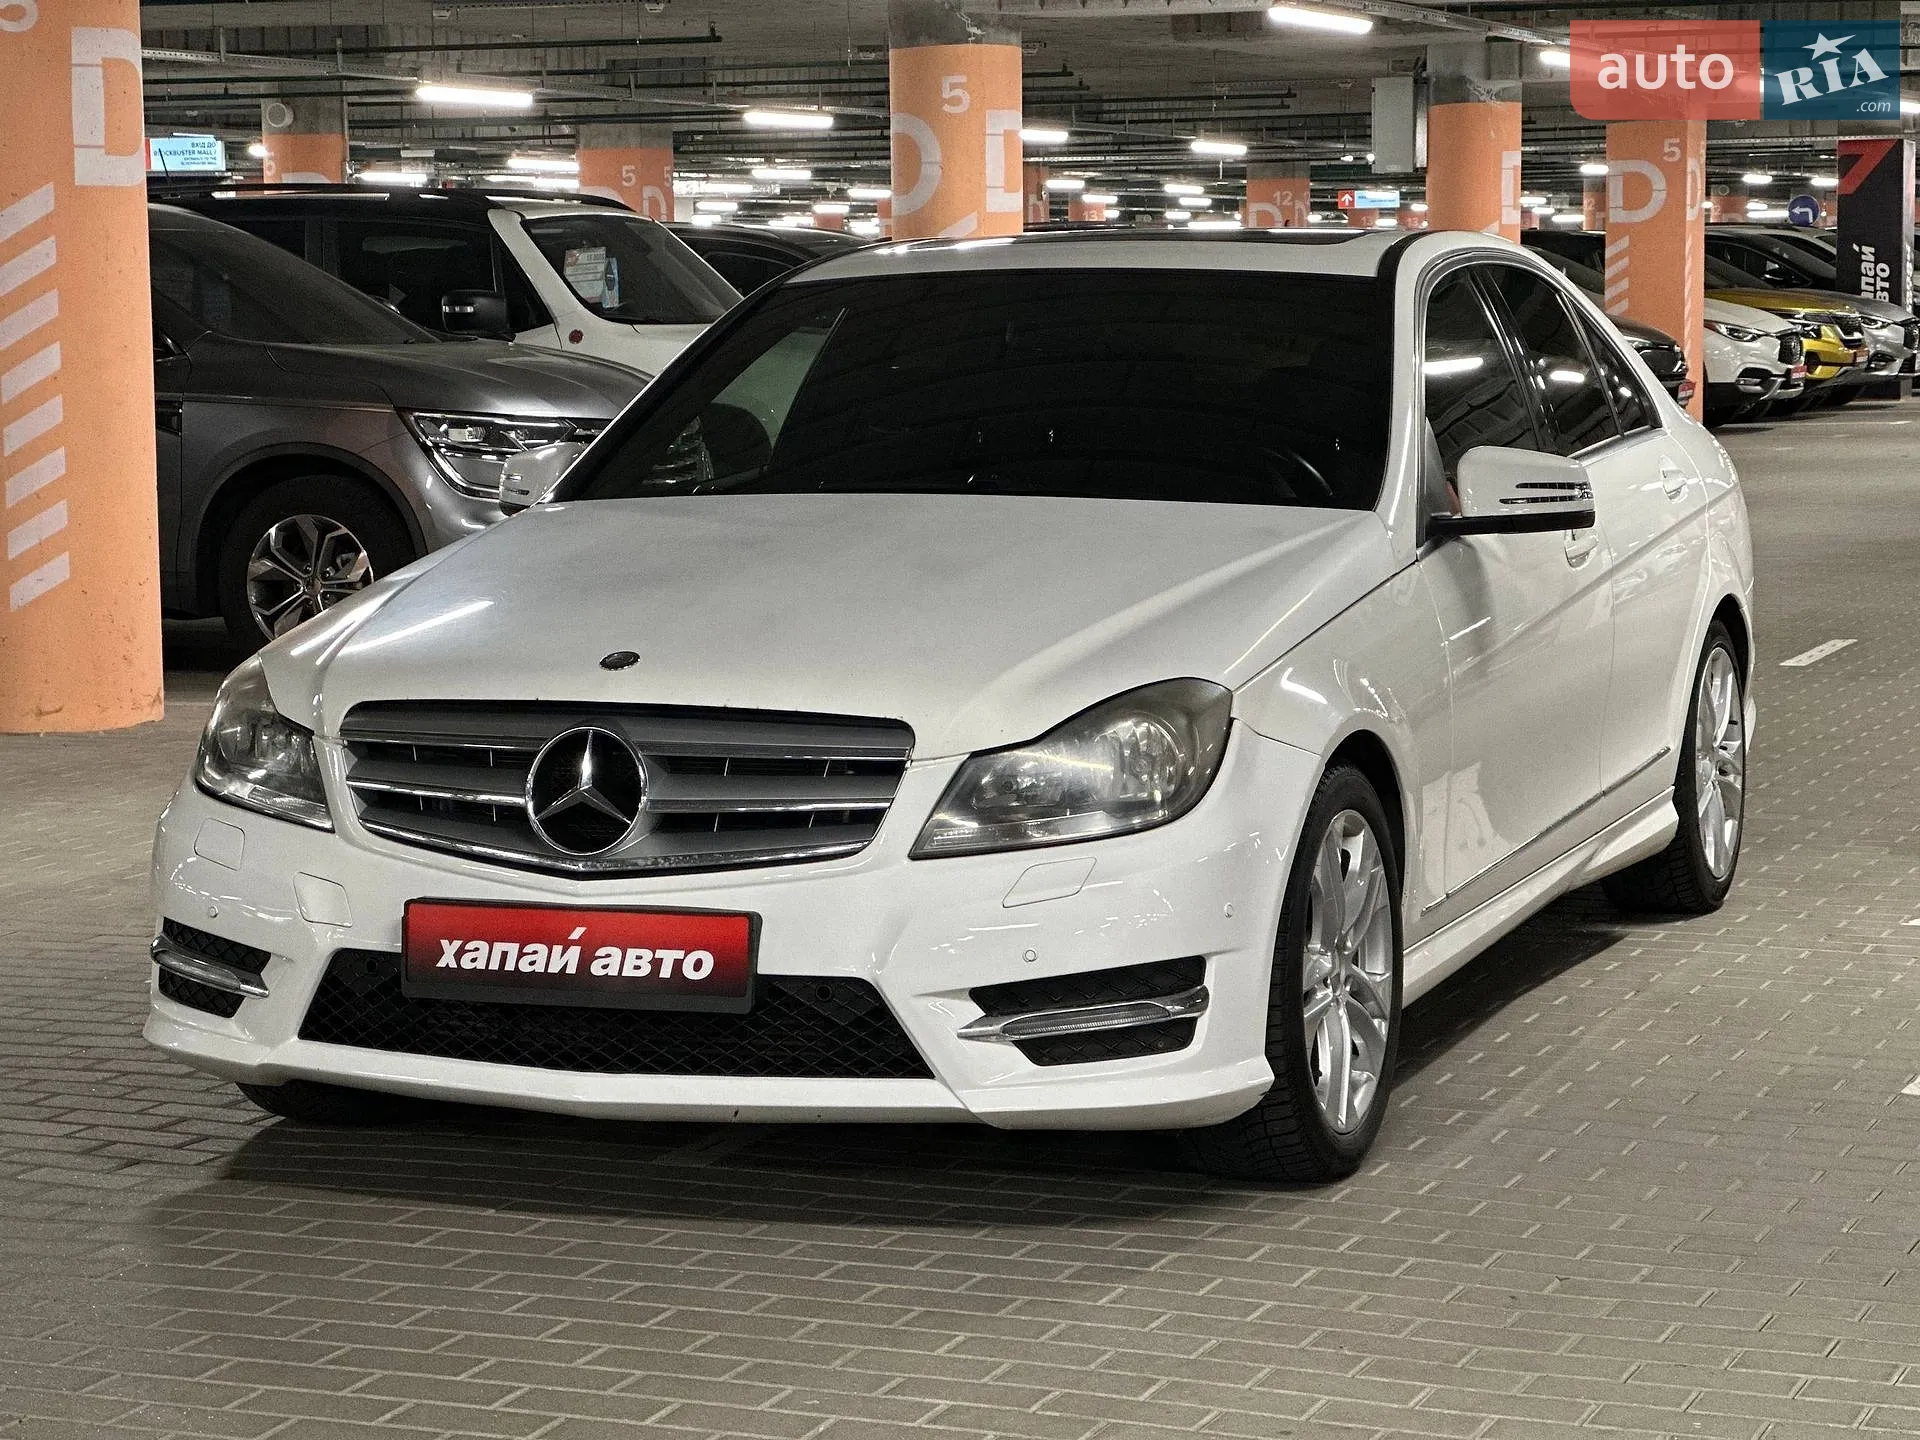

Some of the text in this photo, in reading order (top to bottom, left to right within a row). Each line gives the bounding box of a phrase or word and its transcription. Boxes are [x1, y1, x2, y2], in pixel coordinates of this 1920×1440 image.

[941, 75, 970, 114] 5
[1663, 138, 1681, 163] 5
[622, 165, 637, 187] 5
[1608, 159, 1668, 223] D
[1273, 190, 1293, 206] 12
[436, 927, 715, 981] хапай авто
